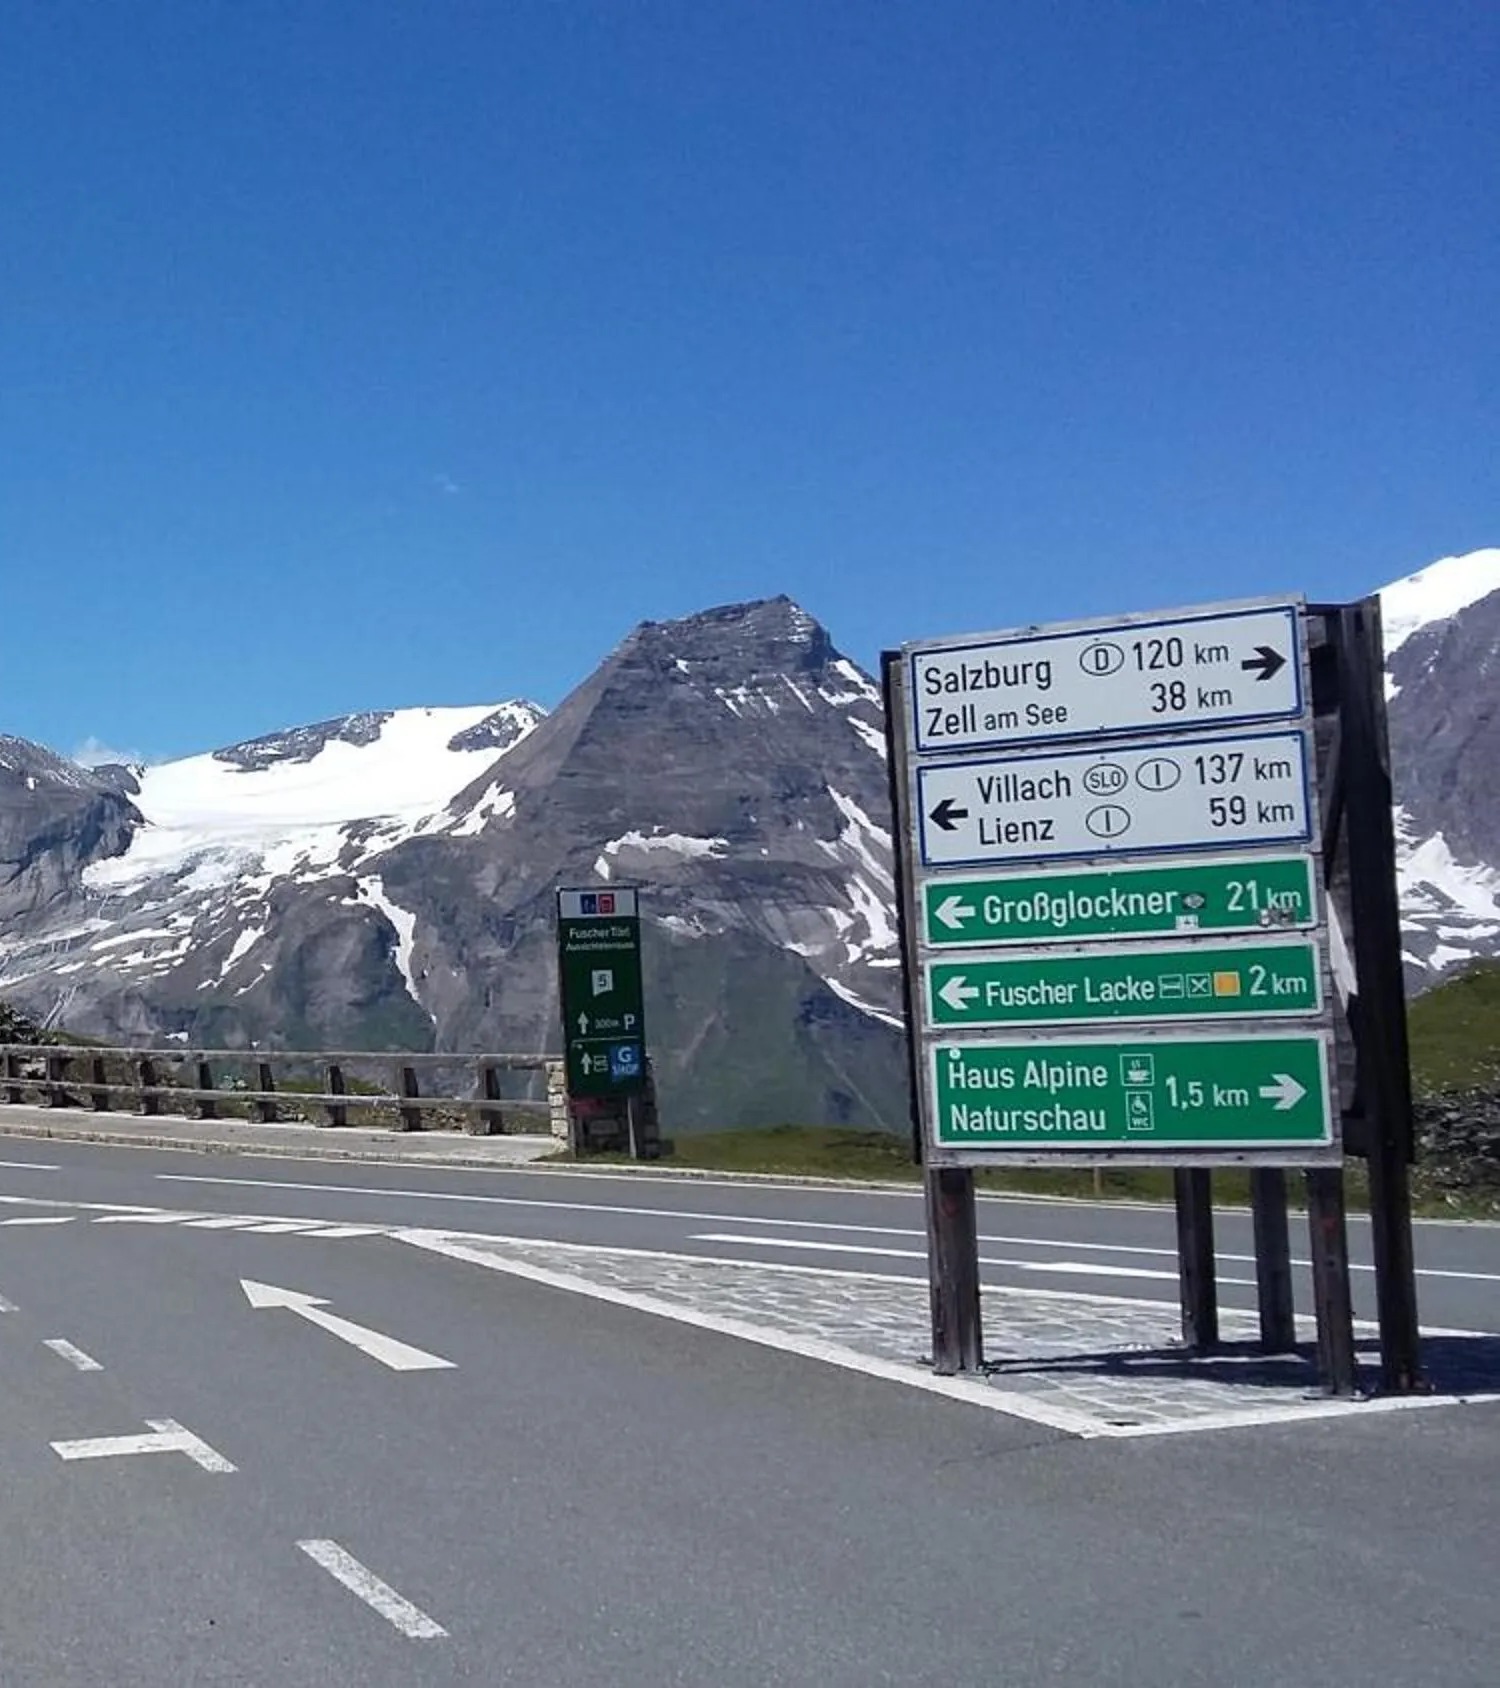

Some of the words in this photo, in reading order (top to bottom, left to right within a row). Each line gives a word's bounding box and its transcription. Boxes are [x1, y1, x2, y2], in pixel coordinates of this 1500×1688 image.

[924, 659, 1052, 696] Salzburg
[1094, 647, 1110, 671] D
[1132, 637, 1183, 671] 120
[1193, 643, 1229, 665] km
[925, 703, 977, 737] Zell
[984, 711, 1019, 731] am
[1025, 703, 1068, 727] See
[1150, 680, 1187, 713] 38
[1197, 687, 1233, 709] km
[976, 769, 1072, 805] Villach
[1154, 763, 1161, 786] I
[1195, 752, 1245, 785] 137
[1253, 757, 1292, 781] km
[978, 817, 1055, 846] Lienz
[1105, 809, 1111, 833] I
[1209, 795, 1247, 827] 59
[1257, 800, 1295, 824] km
[982, 888, 1181, 926] Großglockner
[1226, 879, 1259, 912] 21
[1266, 887, 1302, 910] km
[569, 927, 609, 939] Fuscher
[985, 979, 1077, 1007] Fuscher
[1083, 975, 1155, 1003] Lacke
[1248, 964, 1268, 996] 2
[1271, 972, 1307, 995] km
[624, 1013, 635, 1030] P
[618, 1046, 632, 1063] G
[948, 1061, 1015, 1089] Haus
[1023, 1059, 1108, 1095] Alpine
[1165, 1075, 1204, 1111] 1,5
[1212, 1083, 1249, 1107] km
[950, 1103, 1106, 1132] Naturschau
